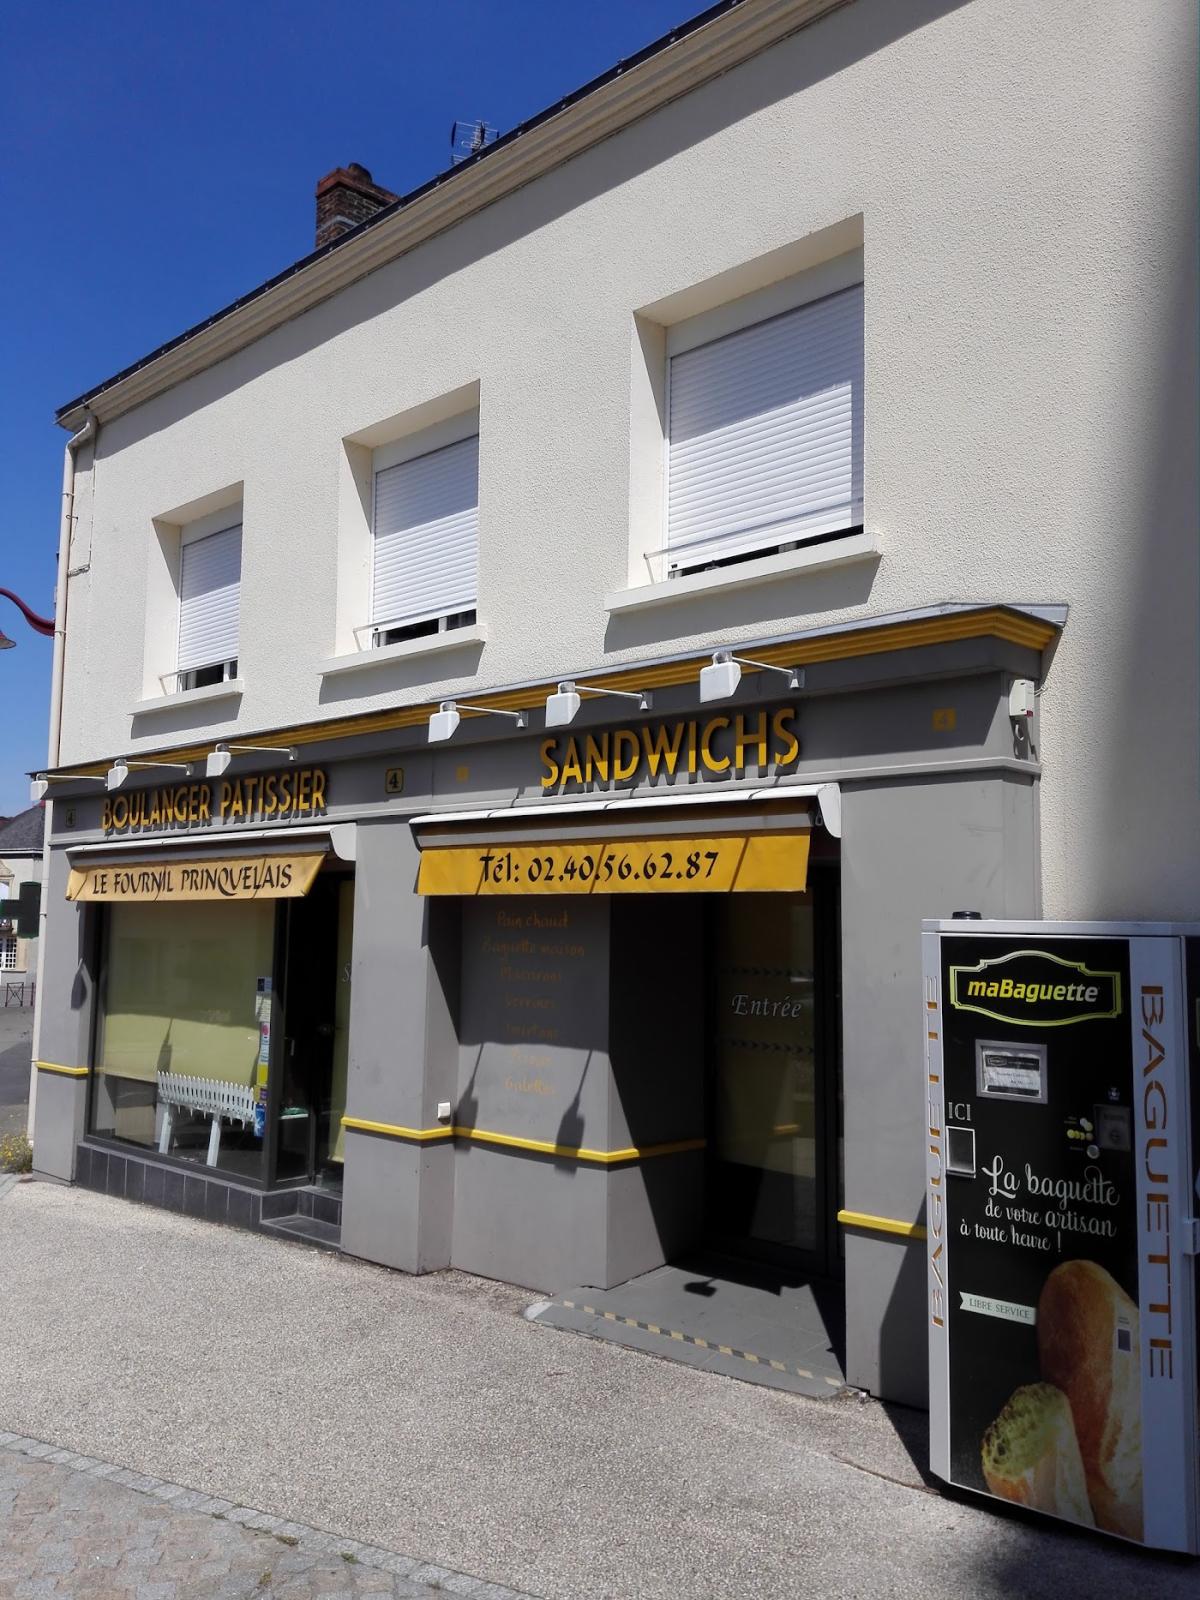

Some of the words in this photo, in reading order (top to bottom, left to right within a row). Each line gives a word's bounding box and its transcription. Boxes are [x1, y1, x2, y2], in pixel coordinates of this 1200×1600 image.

[540, 708, 799, 788] SANDWICHS
[388, 772, 400, 789] 4
[103, 784, 210, 830] BOULANGER
[220, 769, 326, 816] PATISSIER
[93, 873, 107, 895] LE
[114, 869, 174, 895] FOURNIL
[181, 864, 292, 897] PRINQUELAIS
[479, 852, 520, 883] Tél:
[527, 851, 719, 883] 02.40.56.62.87
[731, 994, 801, 1018] Entrée
[967, 978, 1099, 1003] maBaguette
[948, 1102, 971, 1121] ICI
[981, 1155, 1020, 1199] La
[1025, 1163, 1120, 1210] baguette
[1141, 985, 1174, 1380] BAGUETTE
[985, 1197, 1002, 1219] de
[1005, 1206, 1041, 1225] votre
[1045, 1210, 1117, 1238] artisan
[960, 1218, 971, 1236] à
[975, 1222, 1008, 1243] toute
[1011, 1224, 1050, 1250] heure
[969, 1297, 992, 1311] LIBRE
[995, 1302, 1031, 1319] SERVICE
